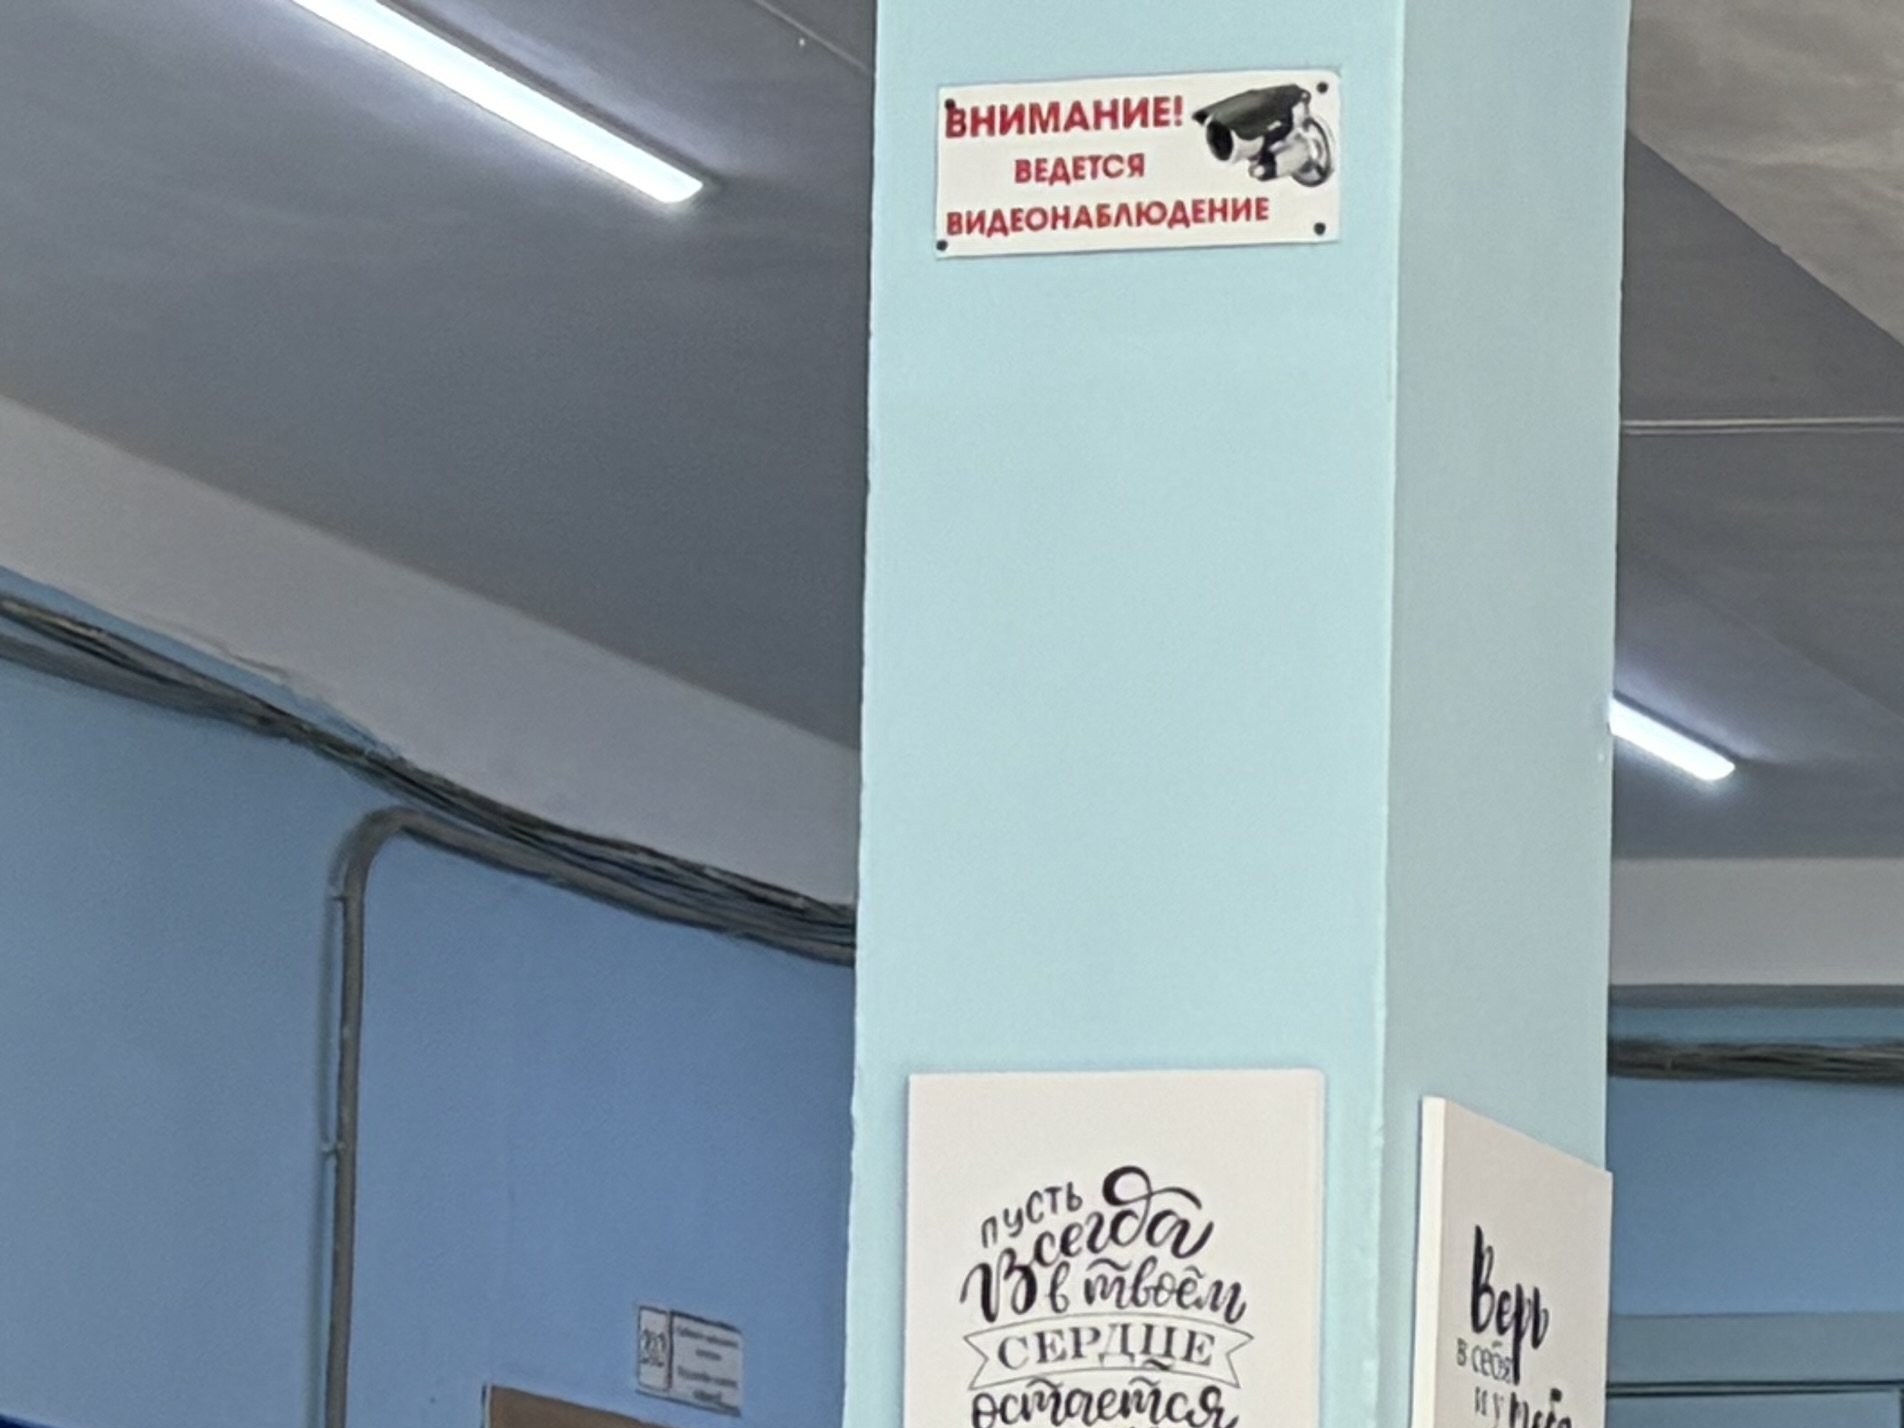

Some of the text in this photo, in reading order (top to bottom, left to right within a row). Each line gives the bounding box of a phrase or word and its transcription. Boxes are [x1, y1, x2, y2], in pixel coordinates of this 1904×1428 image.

[945, 95, 1183, 138] ВНИМАНИЕ!
[1014, 152, 1145, 185] ВЕДЕТСЯ
[946, 197, 1270, 237] ВИДЕОНАБЛЮДЕНИЕ
[997, 1322, 1216, 1371] СЕРДЦЕ
